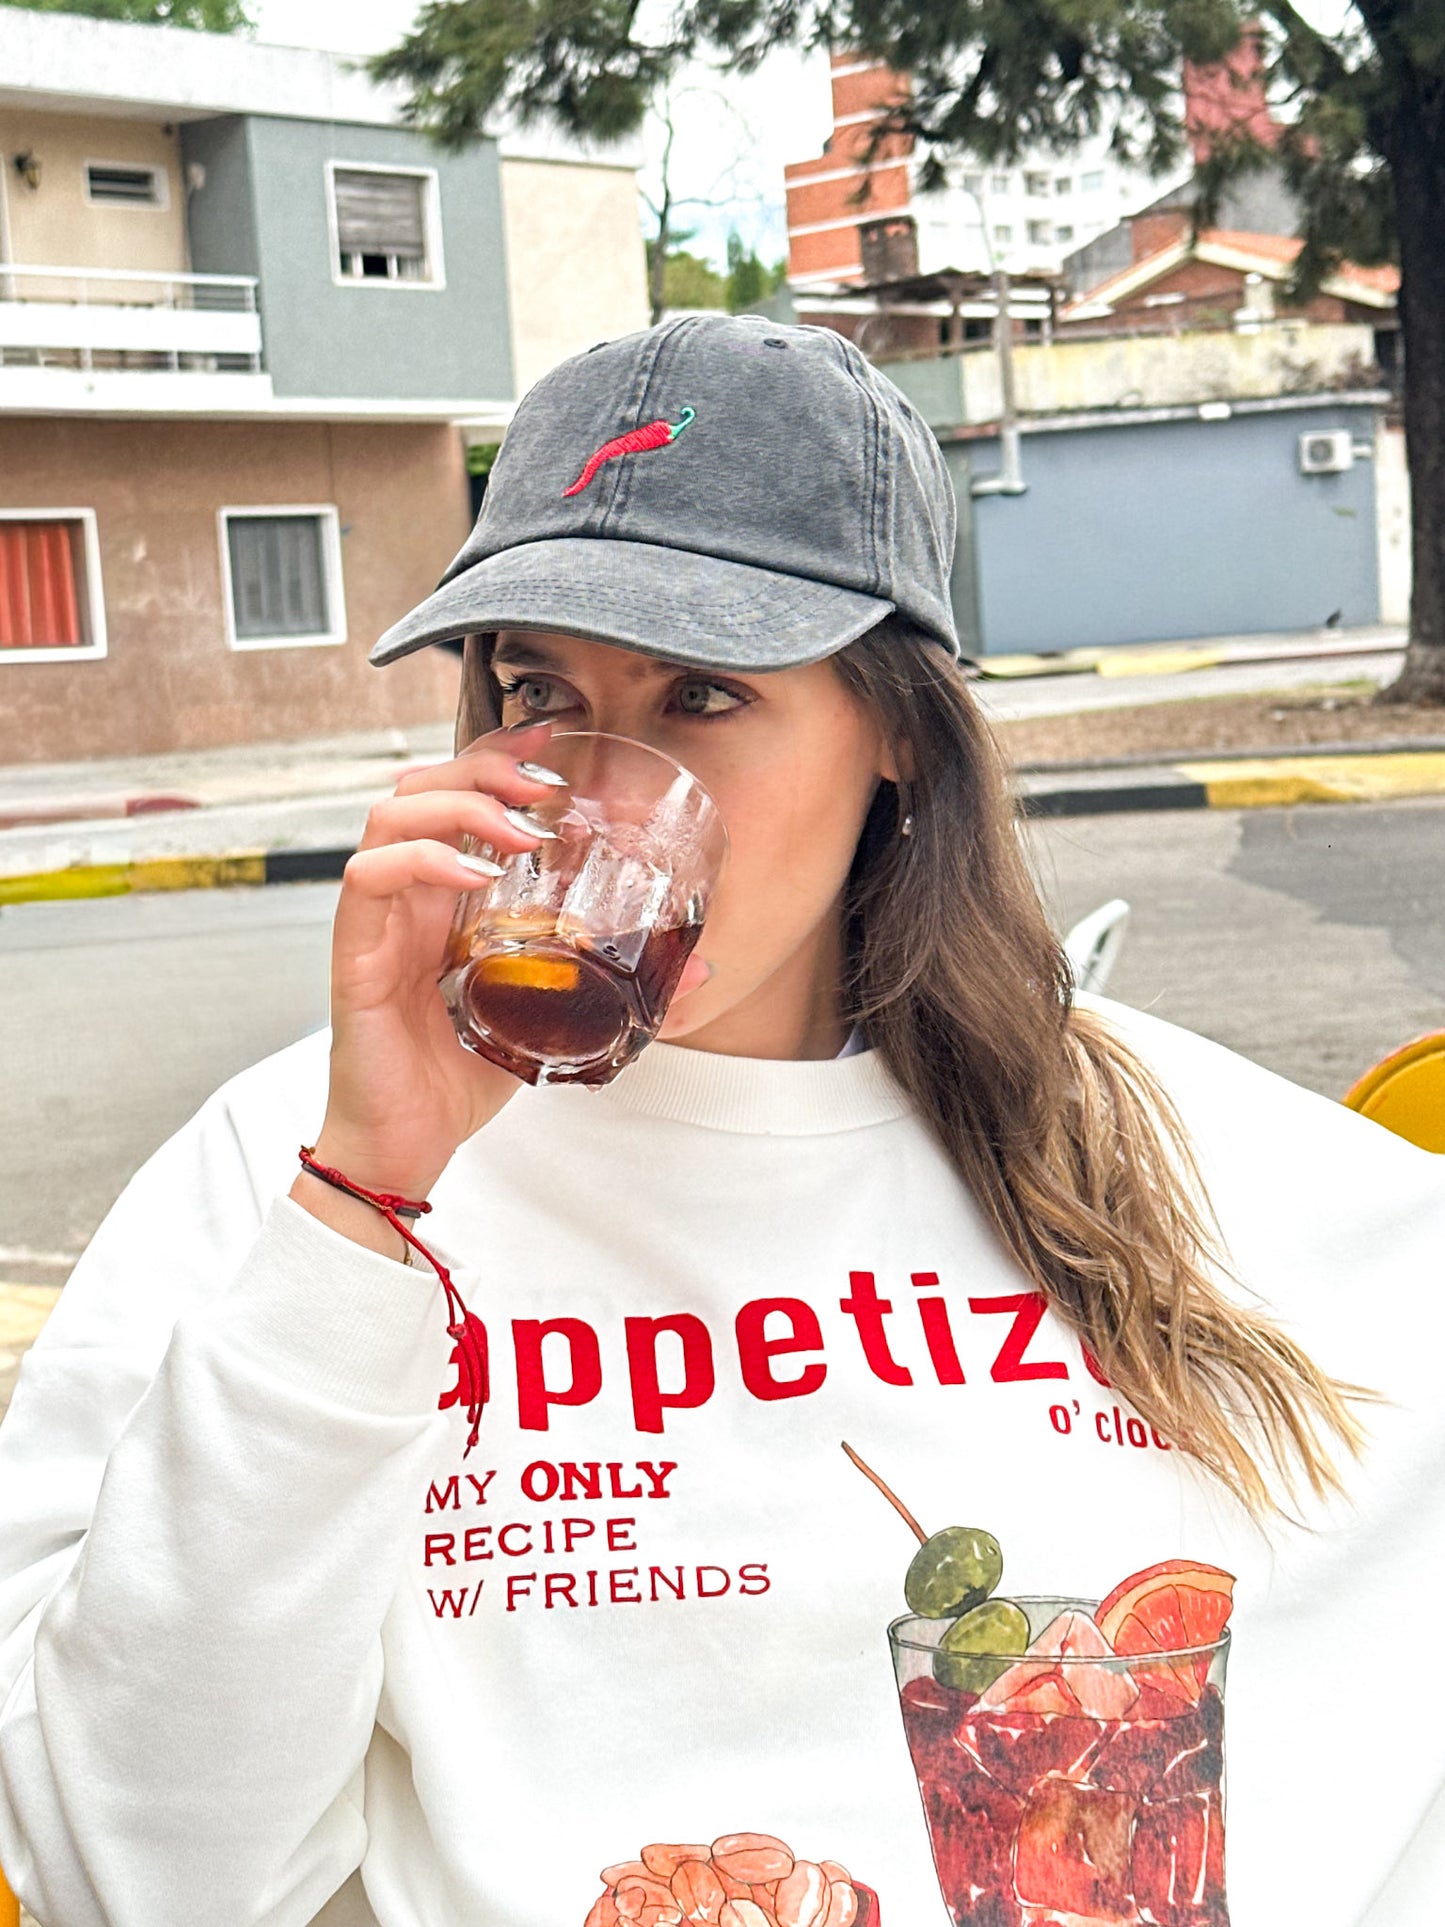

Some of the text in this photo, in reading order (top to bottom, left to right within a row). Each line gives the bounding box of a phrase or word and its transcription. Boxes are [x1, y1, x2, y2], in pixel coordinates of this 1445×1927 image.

[437, 1270, 1114, 1436] appetiz
[1048, 1399, 1191, 1452] o' cloc
[424, 1459, 678, 1513] MY ONLY
[424, 1517, 638, 1567] RECIPE
[427, 1563, 772, 1619] W/ FRIENDS
